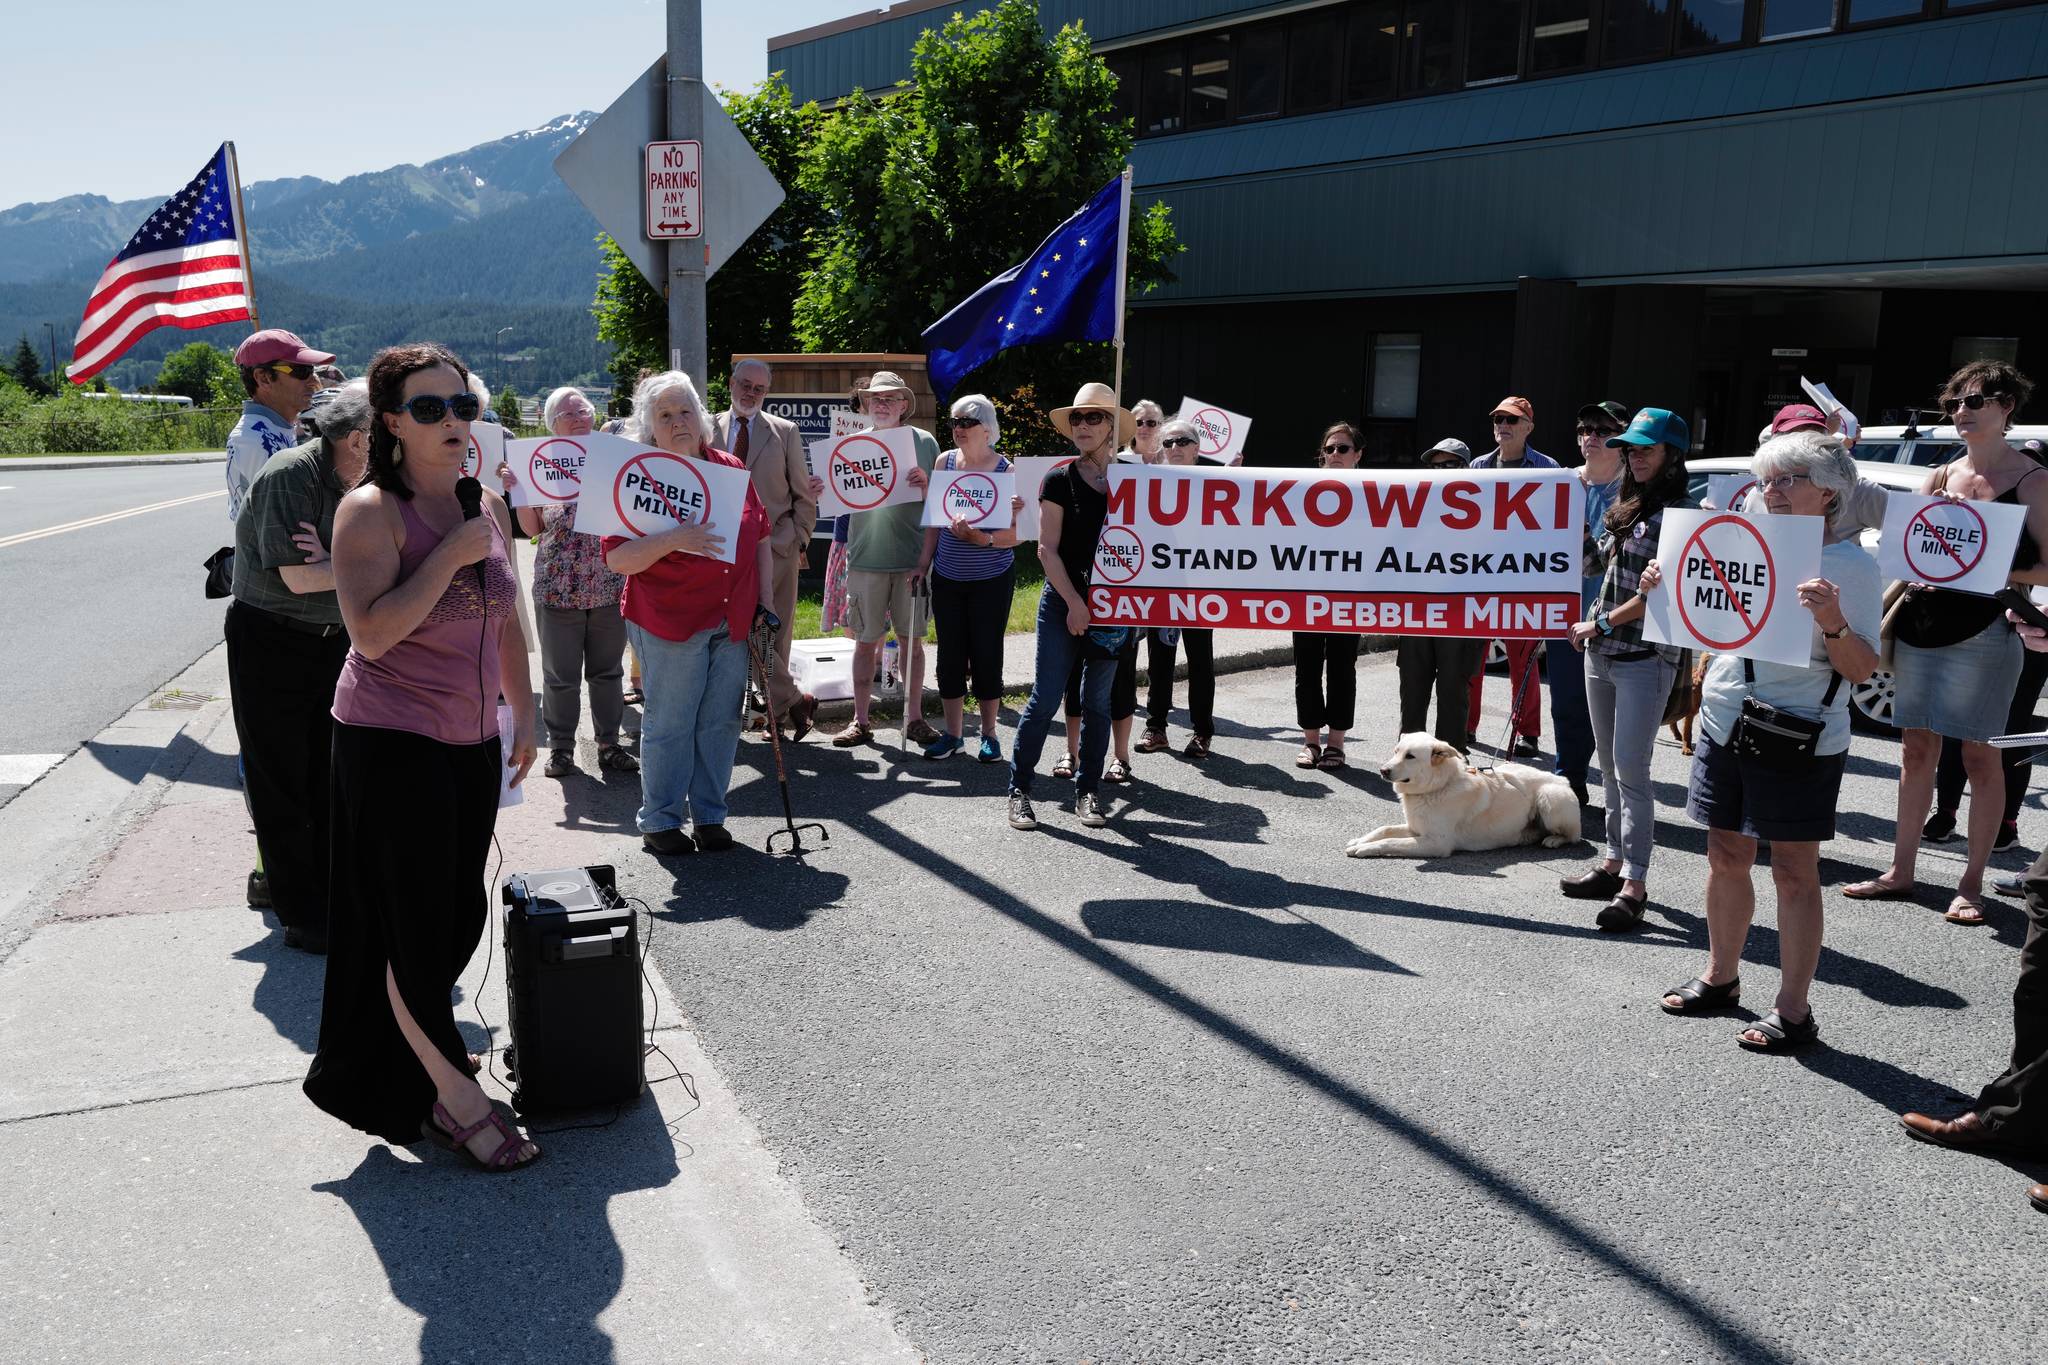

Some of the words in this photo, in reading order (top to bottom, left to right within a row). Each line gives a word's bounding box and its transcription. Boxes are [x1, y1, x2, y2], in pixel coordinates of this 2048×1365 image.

[664, 151, 683, 168] NO
[651, 171, 697, 189] PARKING
[664, 192, 684, 204] ANY
[662, 206, 687, 218] TIME
[767, 403, 813, 418] GOLD
[1195, 419, 1228, 436] PEBBLE
[535, 456, 586, 470] PEBBLE
[834, 456, 890, 476] PEBBLE
[545, 469, 578, 481] MINE
[843, 474, 884, 491] MINE
[626, 472, 704, 509] PEBBLE
[949, 488, 993, 500] PEBBLE
[633, 494, 690, 521] MINE
[955, 498, 983, 510] MINE
[1103, 478, 1570, 531] MURKOWSKI
[1912, 523, 1980, 544] PEBBLE
[1097, 544, 1139, 556] PEBBLE
[1920, 540, 1962, 559] MINE
[1103, 556, 1133, 568] MINE
[1687, 556, 1766, 587] PEBBLE
[1169, 594, 1228, 623] NO
[1242, 598, 1291, 624] TO
[1695, 586, 1752, 615] MINE
